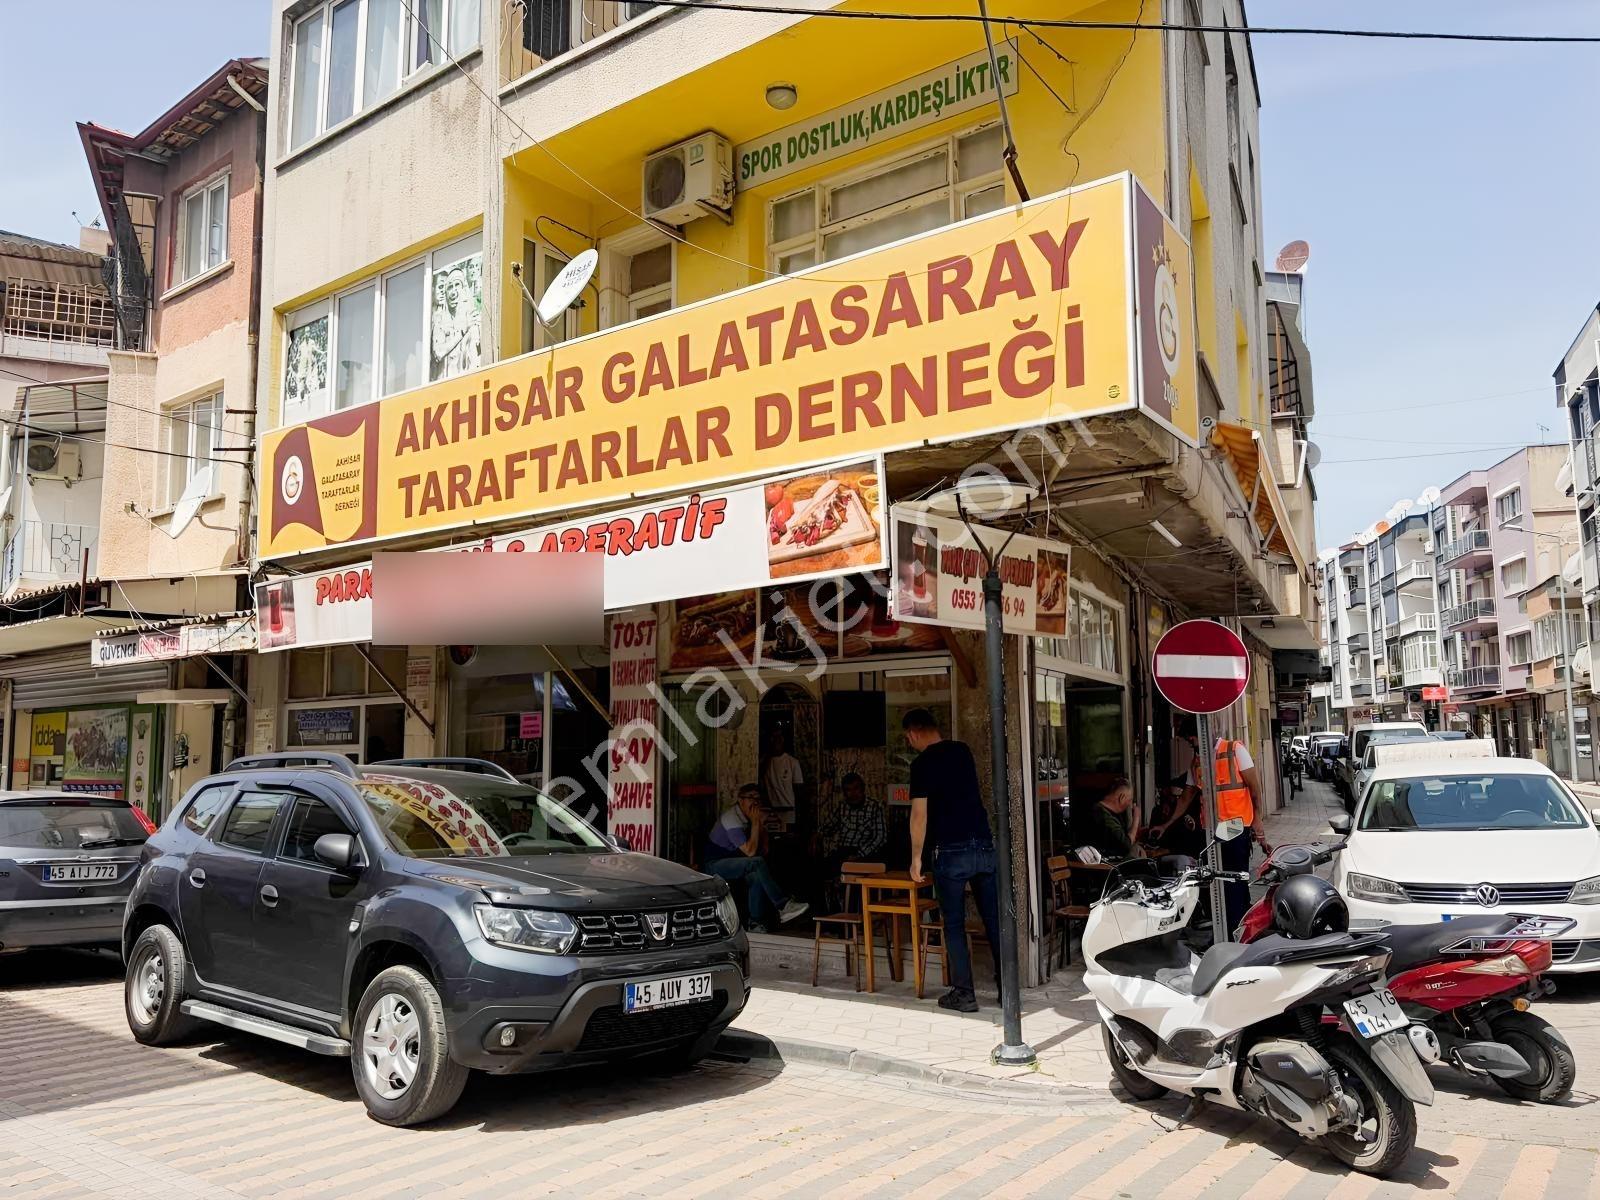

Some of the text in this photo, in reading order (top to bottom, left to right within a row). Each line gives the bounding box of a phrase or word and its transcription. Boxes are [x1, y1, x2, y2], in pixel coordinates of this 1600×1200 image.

[741, 142, 782, 180] SPOR
[396, 219, 1089, 456] AKHİSAR GALATASARAY
[397, 303, 1086, 518] TARAFTARLAR DERNEĞİ
[952, 588, 976, 611] 0553
[1013, 597, 1025, 617] 94
[613, 620, 657, 649] TOST
[612, 738, 653, 773] ÇAY
[613, 783, 652, 810] KAHVE
[51, 866, 115, 879] 45 AIJ 772
[636, 976, 711, 1004] 45 AUV 337
[1349, 990, 1396, 1017] 45 YG
[1367, 1012, 1393, 1033] 141
